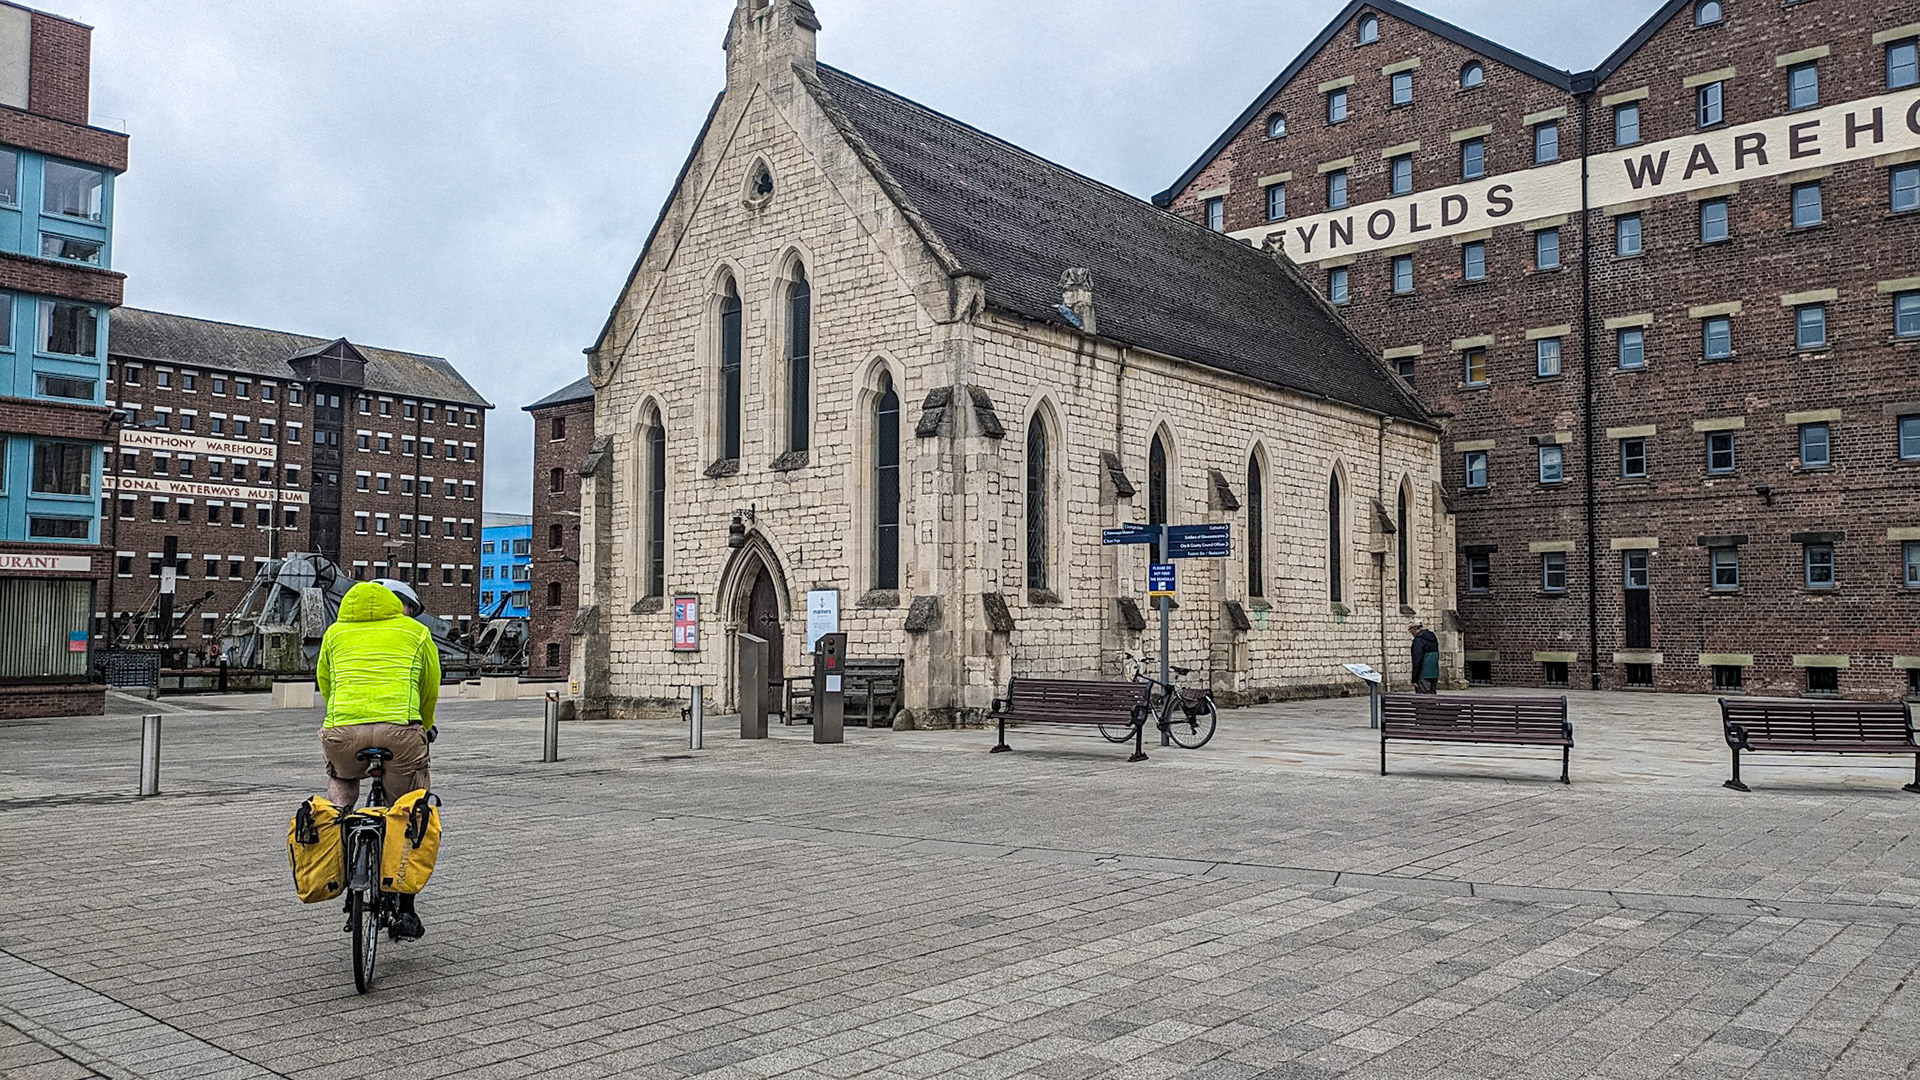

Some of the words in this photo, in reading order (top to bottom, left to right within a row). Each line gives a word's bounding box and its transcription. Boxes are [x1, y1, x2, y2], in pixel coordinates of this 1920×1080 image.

[1238, 184, 1513, 253] YNOLDS
[123, 433, 196, 448] LLANTHONY
[206, 441, 274, 456] WAREHOUSE
[169, 482, 240, 497] WATERWAYS
[247, 490, 303, 501] MUSEUM
[0, 556, 59, 569] URANT
